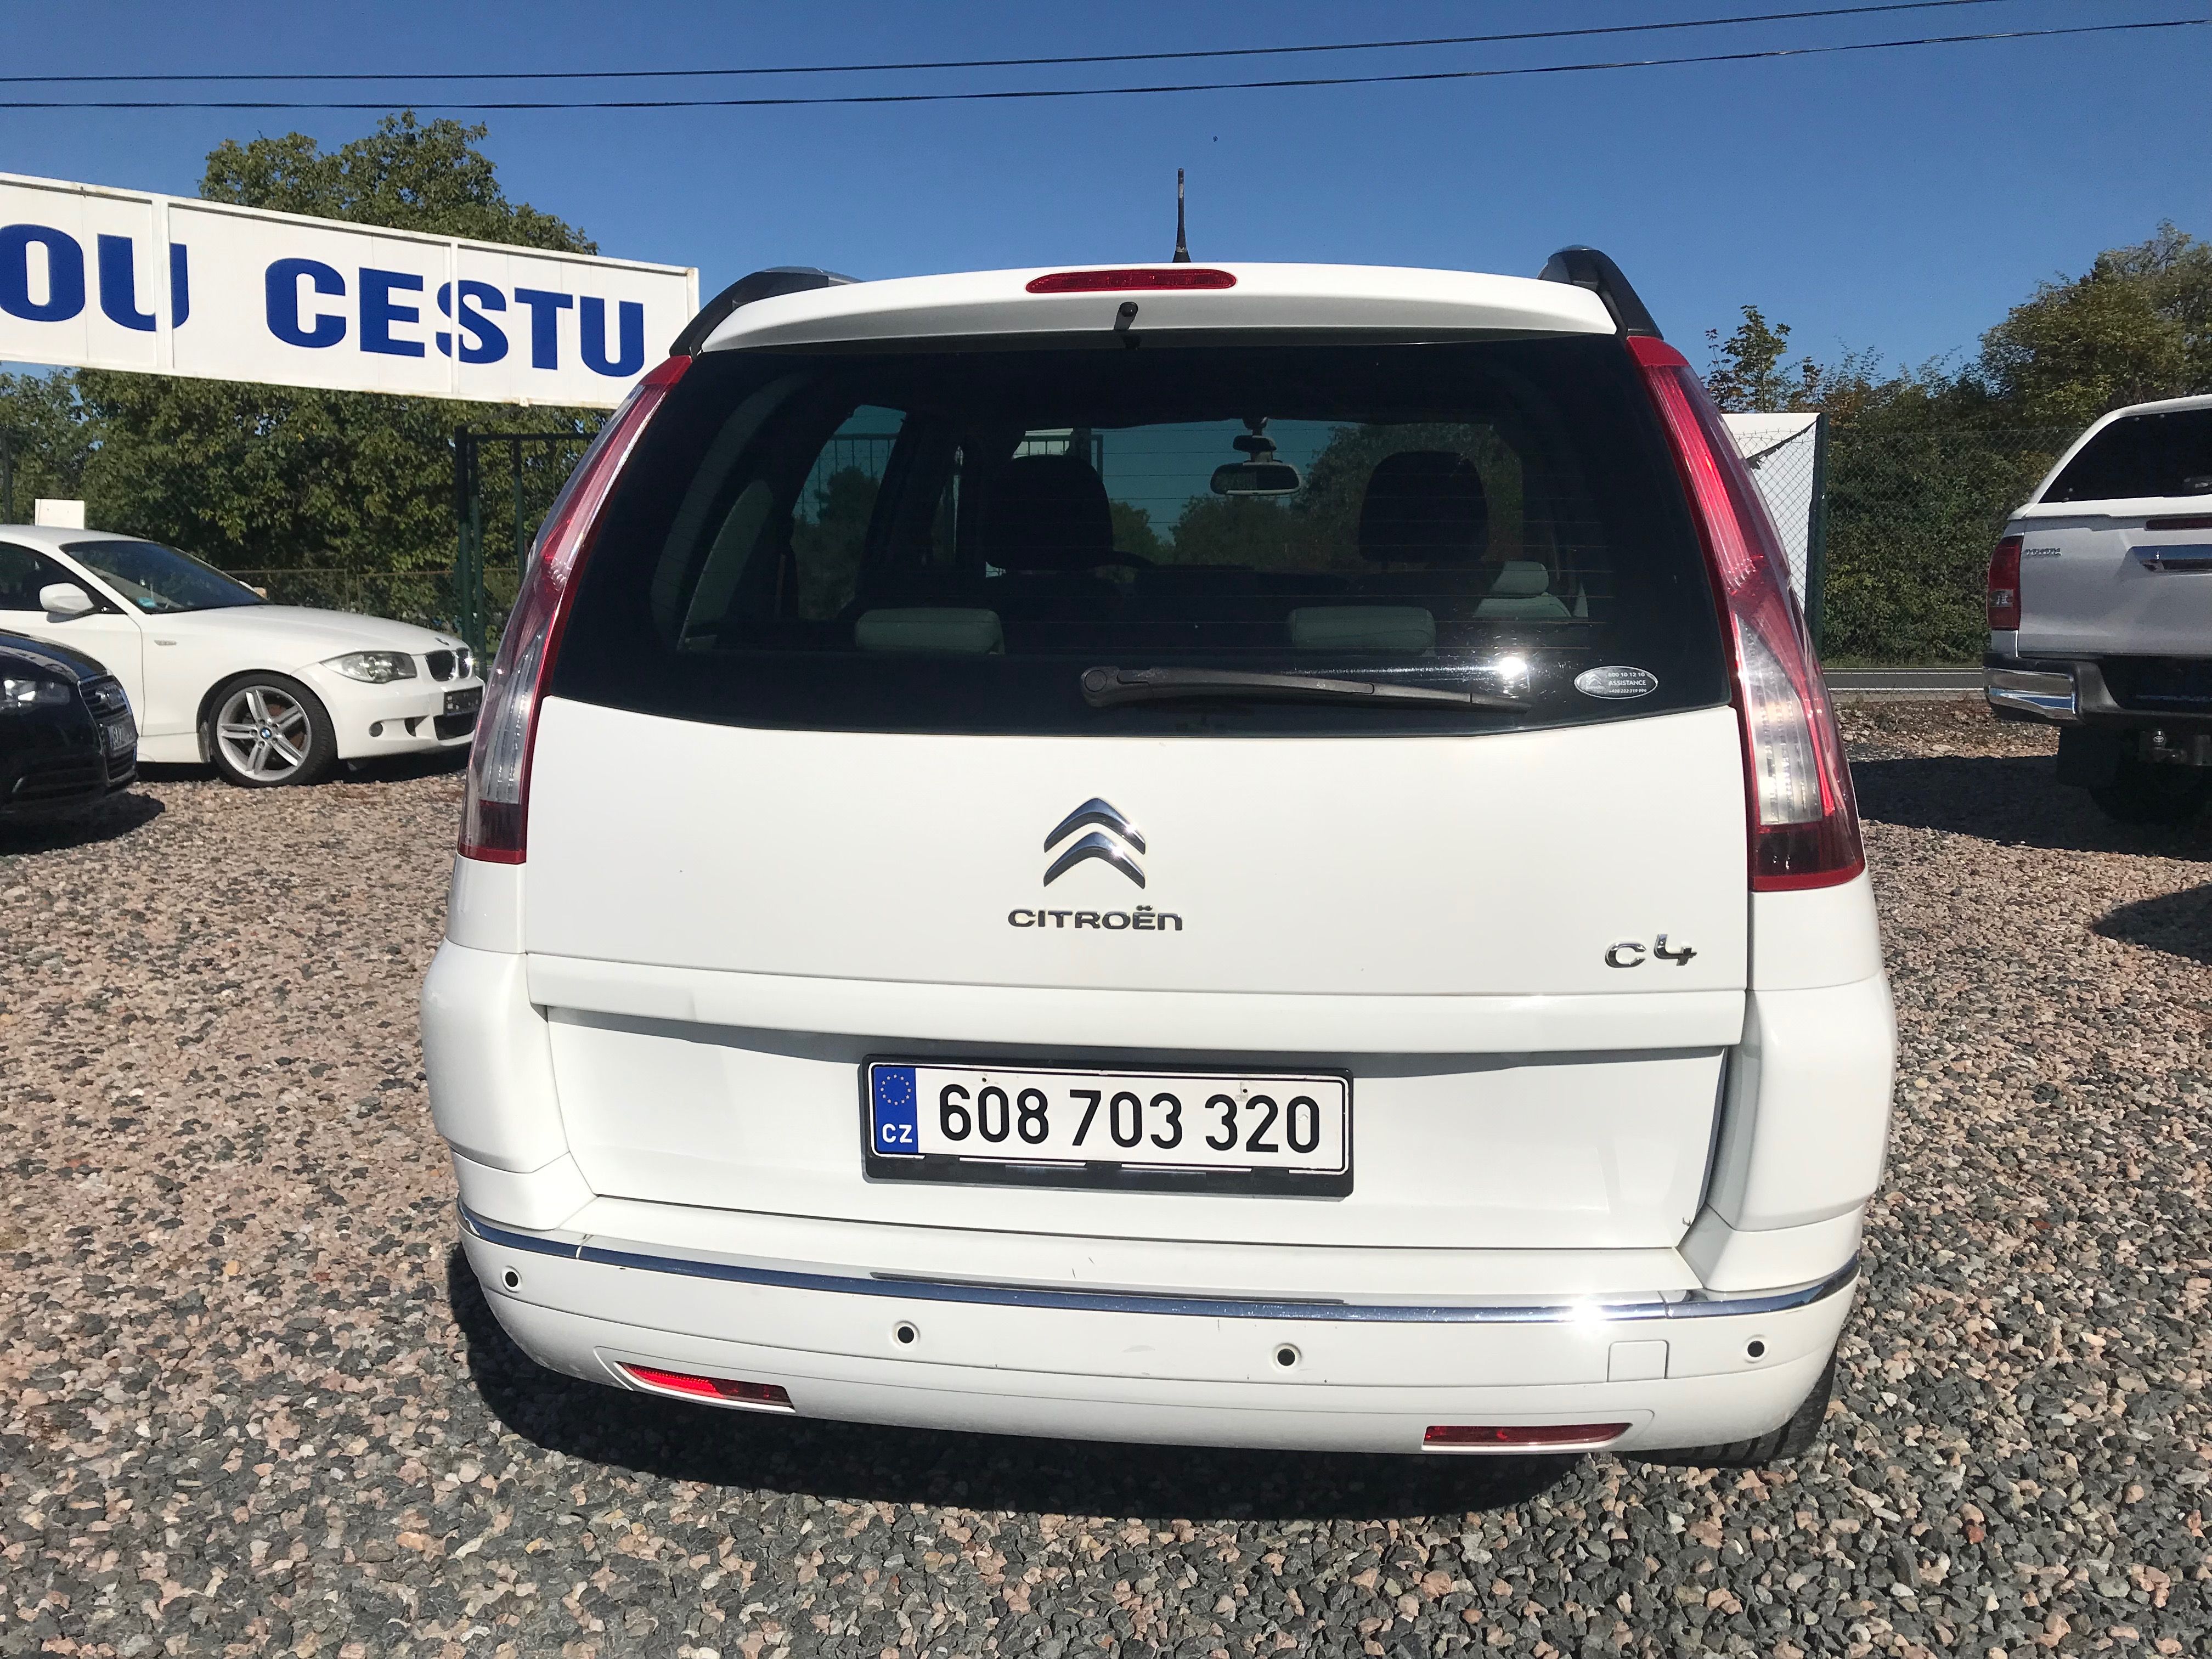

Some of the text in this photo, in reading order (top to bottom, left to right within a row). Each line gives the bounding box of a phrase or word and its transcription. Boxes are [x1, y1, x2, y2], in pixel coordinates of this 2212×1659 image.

[0, 223, 645, 377] OU CESTU
[1008, 905, 1182, 930] CITROËN
[1605, 934, 1697, 968] C4
[882, 1123, 913, 1143] CZ
[939, 1084, 1319, 1154] 608 703 320
